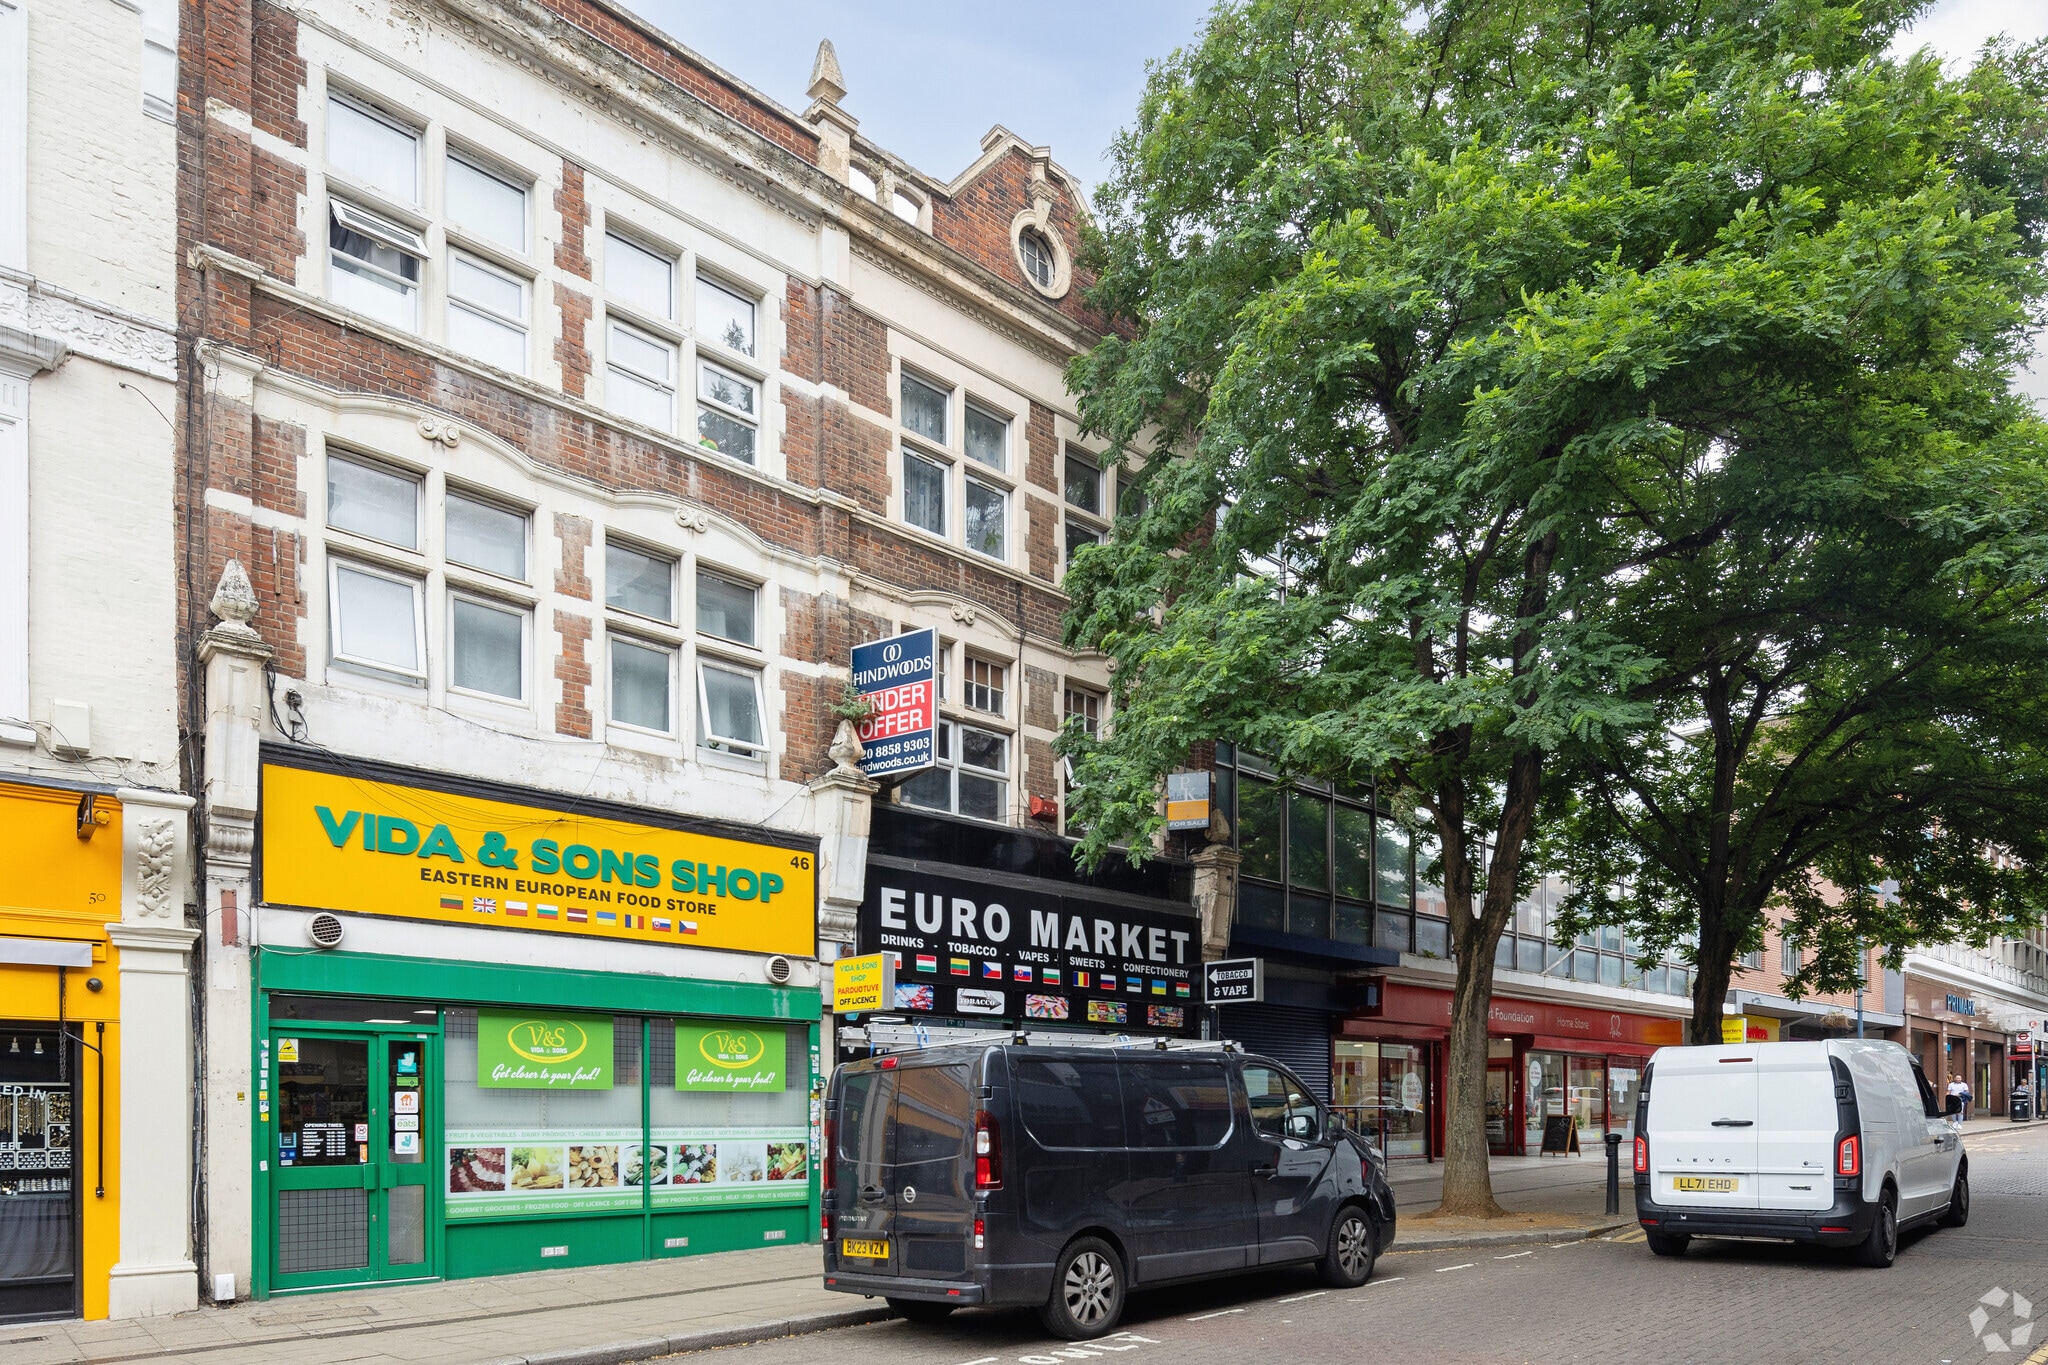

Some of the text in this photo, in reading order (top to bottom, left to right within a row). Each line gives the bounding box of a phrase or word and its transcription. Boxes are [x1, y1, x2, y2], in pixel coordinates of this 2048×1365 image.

[853, 655, 931, 686] HINDWOODS
[858, 684, 925, 713] NDER
[860, 708, 923, 739] OFFER
[875, 742, 900, 758] 8858
[903, 737, 930, 752] 9303
[314, 805, 784, 903] VIDA & SONS SHOP
[790, 855, 810, 870] 46
[89, 892, 106, 905] 50
[420, 868, 717, 915] EASTERN EUROPEAN FOOD STORE
[881, 886, 1190, 965] EURO MARKET
[881, 933, 1189, 978] DRINKS TOBACCO VAPES SWEETS CONFECTIONERY
[855, 963, 860, 971] &
[861, 961, 878, 969] SONS
[1217, 970, 1248, 980] TOBACCO
[850, 974, 866, 982] SHOP
[1213, 985, 1248, 997] & VAPE
[839, 996, 877, 1006] OFF LICENCE
[959, 998, 995, 1006] TOBACCO
[1946, 994, 1976, 1016] PRIMARK
[1495, 1007, 1534, 1024] Foundation
[1557, 1016, 1589, 1030] Home Store
[527, 1026, 566, 1047] V&S
[716, 1034, 747, 1054] V&S
[492, 1063, 601, 1085] Get closer to your food!
[687, 1068, 776, 1088] Get closer to your food!
[2, 1085, 47, 1101] ED IN
[1680, 1178, 1731, 1190] LL71 EHD
[450, 1206, 483, 1214] GOURMET
[484, 1204, 521, 1213] GROCERIES
[524, 1203, 550, 1211] FROZEN
[586, 1200, 611, 1208] LICENCE
[847, 1241, 867, 1254] BK23
[1018, 1335, 1161, 1364] ONLY
